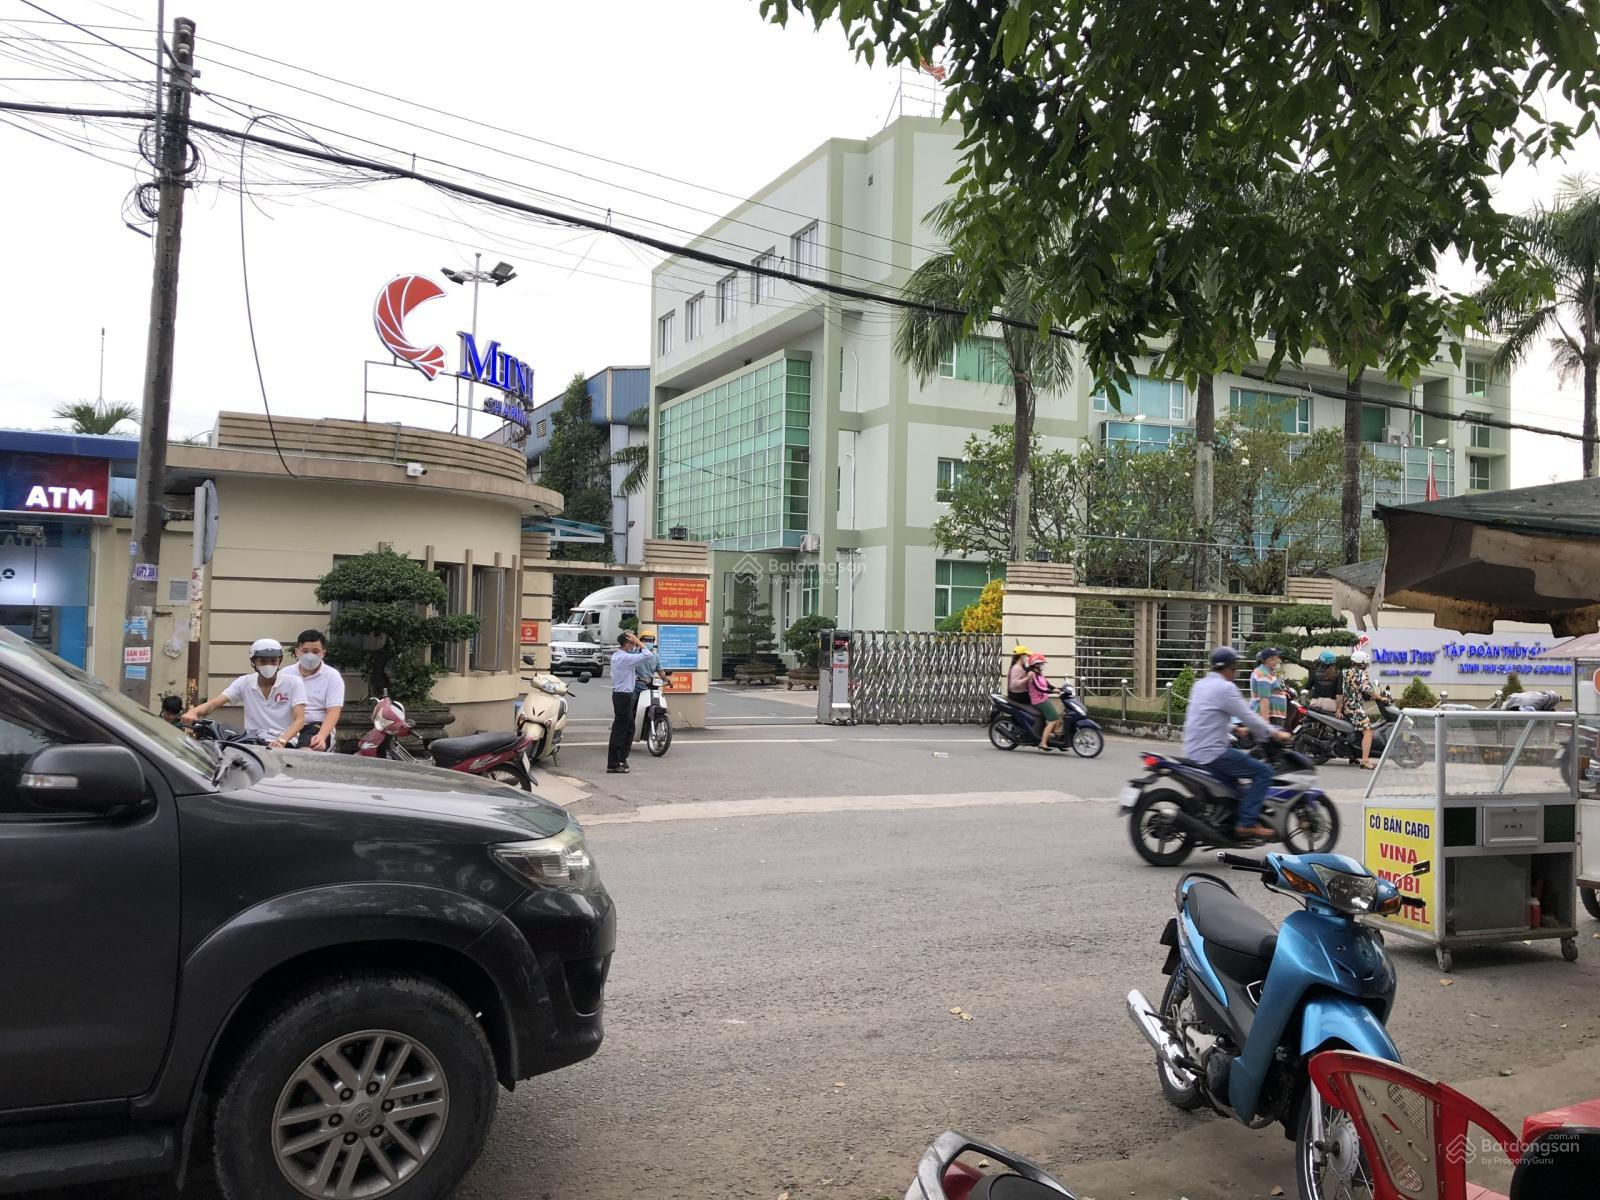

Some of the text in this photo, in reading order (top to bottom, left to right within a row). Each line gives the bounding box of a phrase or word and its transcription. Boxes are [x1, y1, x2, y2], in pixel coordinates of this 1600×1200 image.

[25, 486, 94, 510] ATM
[1443, 641, 1466, 661] TẬP
[1469, 641, 1500, 659] ĐOÀN
[1369, 813, 1430, 840] CÓ BÁN CARD
[1379, 842, 1418, 865] VINA
[1377, 869, 1420, 894] MOBI
